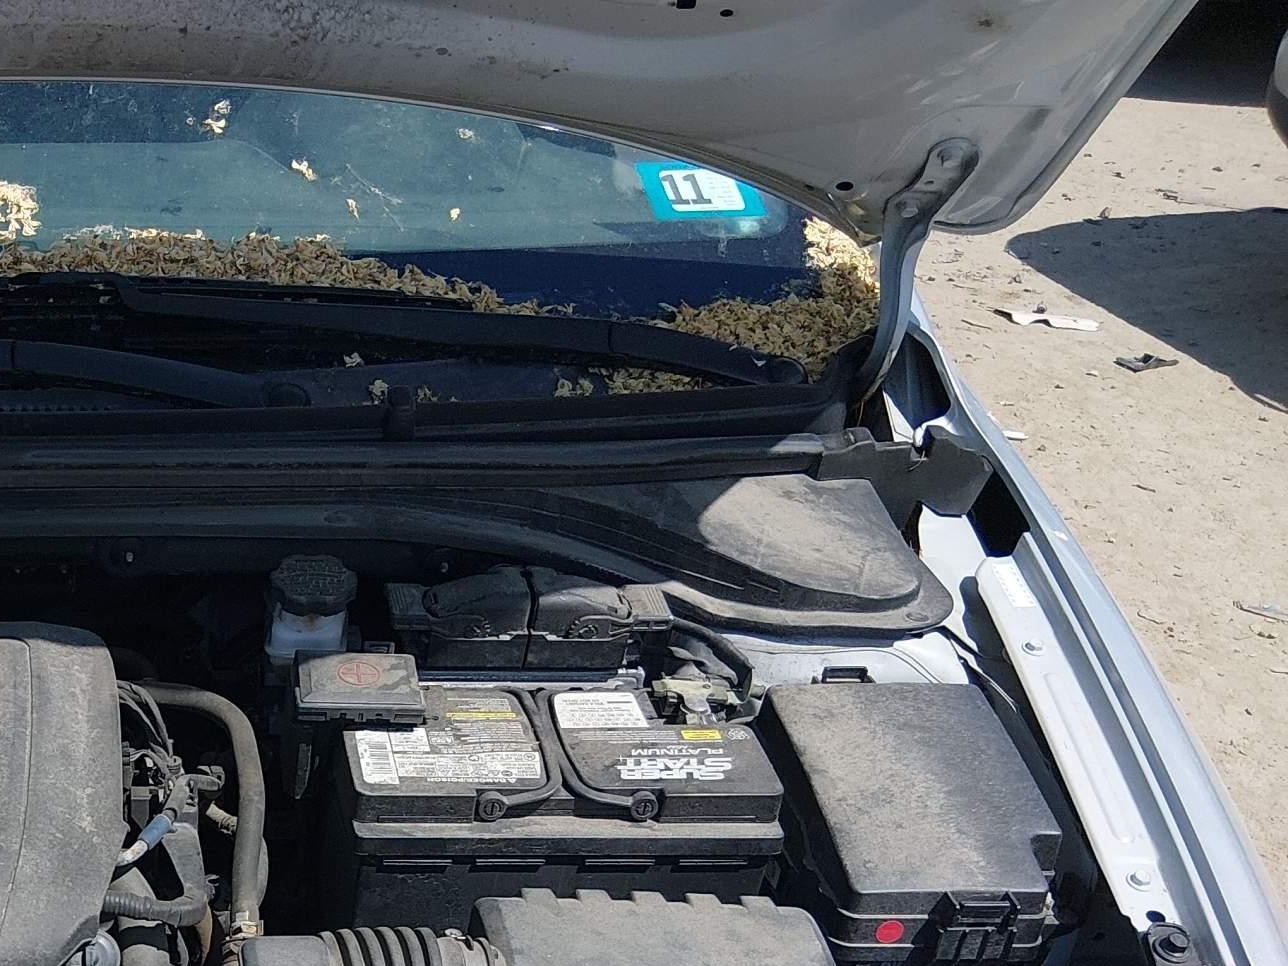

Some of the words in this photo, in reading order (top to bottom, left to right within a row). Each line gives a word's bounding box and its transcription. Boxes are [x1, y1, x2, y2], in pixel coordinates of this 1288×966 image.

[661, 173, 713, 205] 11
[631, 748, 725, 756] PLATINUM
[614, 757, 733, 771] START
[620, 768, 725, 780] SUPER
